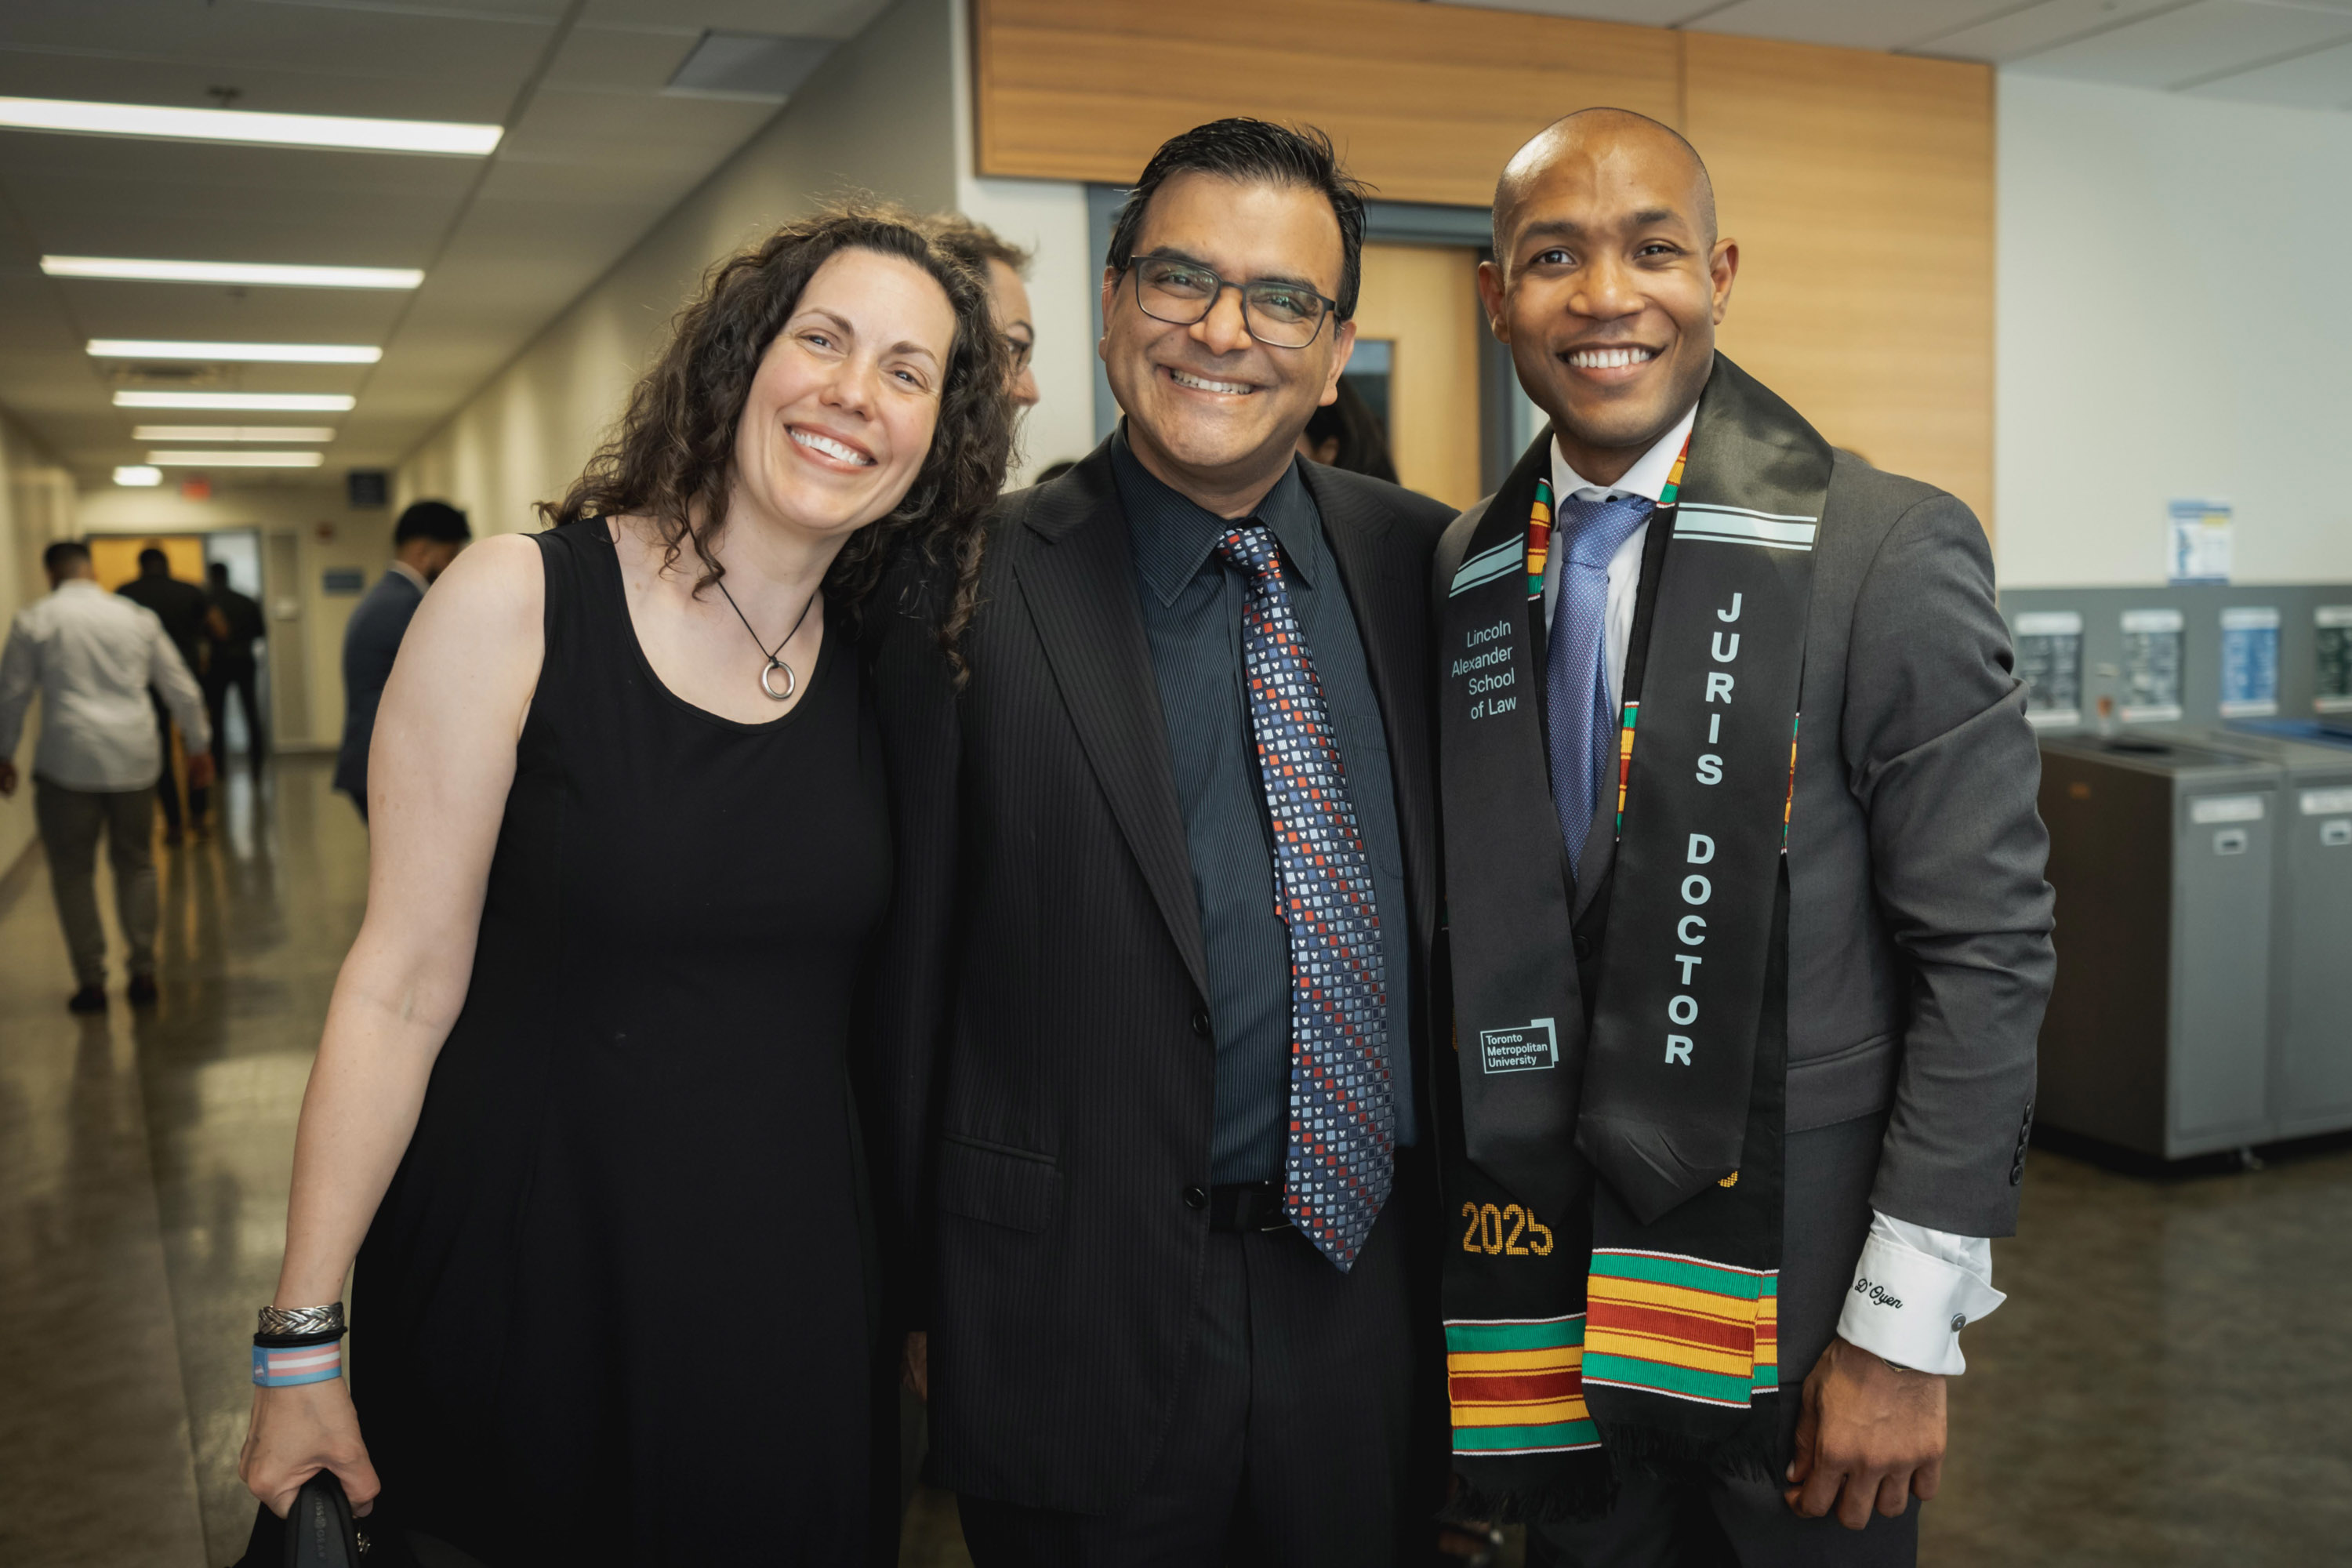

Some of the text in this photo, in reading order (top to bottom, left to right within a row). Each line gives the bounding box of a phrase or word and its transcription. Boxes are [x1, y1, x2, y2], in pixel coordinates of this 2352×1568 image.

[1467, 620, 1512, 648] Lincoln
[1451, 646, 1513, 678] Alexander
[1468, 667, 1515, 695] School
[1471, 696, 1516, 720] of Law
[1664, 592, 1743, 1066] JURIS DOCTOR
[1486, 1034, 1523, 1046] Toronto
[1487, 1043, 1548, 1056] Metropolitan
[1488, 1054, 1537, 1068] University
[1462, 1201, 1554, 1256] 2025
